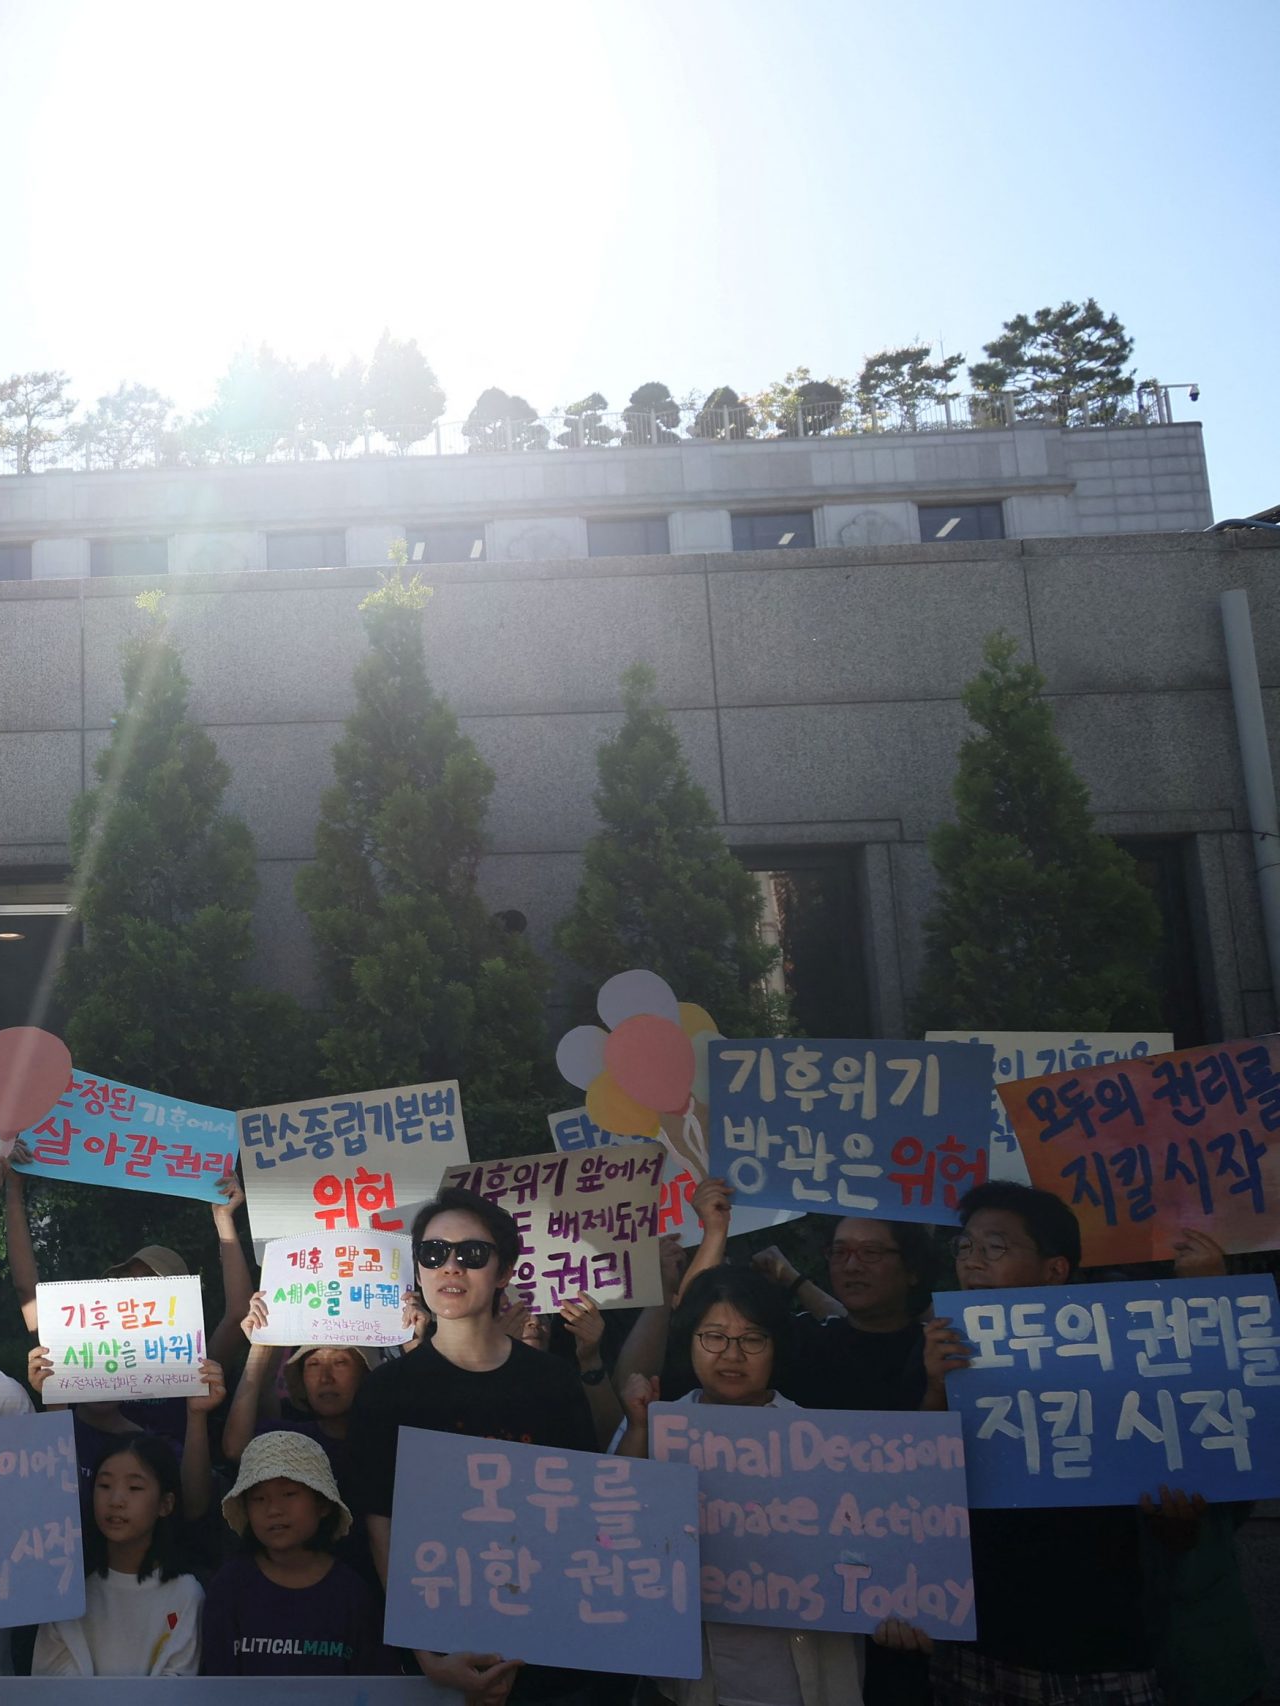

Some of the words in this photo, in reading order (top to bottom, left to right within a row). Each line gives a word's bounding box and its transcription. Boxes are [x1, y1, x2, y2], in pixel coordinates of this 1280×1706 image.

[719, 1044, 942, 1121] 기후위기
[1026, 1072, 1145, 1143] 모두의
[137, 1101, 236, 1142] 기후에서
[241, 1086, 456, 1170] 탄소중립기본법
[575, 1151, 665, 1194] 앞에서
[723, 1114, 885, 1212] 방관은
[1061, 1143, 1158, 1227] 지킬
[1164, 1128, 1269, 1214] 시작
[312, 1165, 404, 1232] 위헌
[287, 1247, 323, 1275] 기후
[542, 1250, 635, 1308] 권리
[60, 1300, 110, 1330] 기후
[273, 1280, 342, 1317] 세상을
[63, 1338, 137, 1373] 세상을
[963, 1302, 1115, 1372] 모두의
[1124, 1294, 1280, 1387] 권리를
[652, 1414, 782, 1479] Final
[789, 1419, 965, 1474] Decision
[975, 1389, 1093, 1479] 지킬
[1115, 1388, 1256, 1473] 시작
[462, 1452, 641, 1549] 모두를
[828, 1492, 970, 1544] Action
[411, 1541, 541, 1616] 위한
[563, 1550, 687, 1624] 권리
[700, 1561, 825, 1621] egins
[833, 1562, 976, 1627] Today
